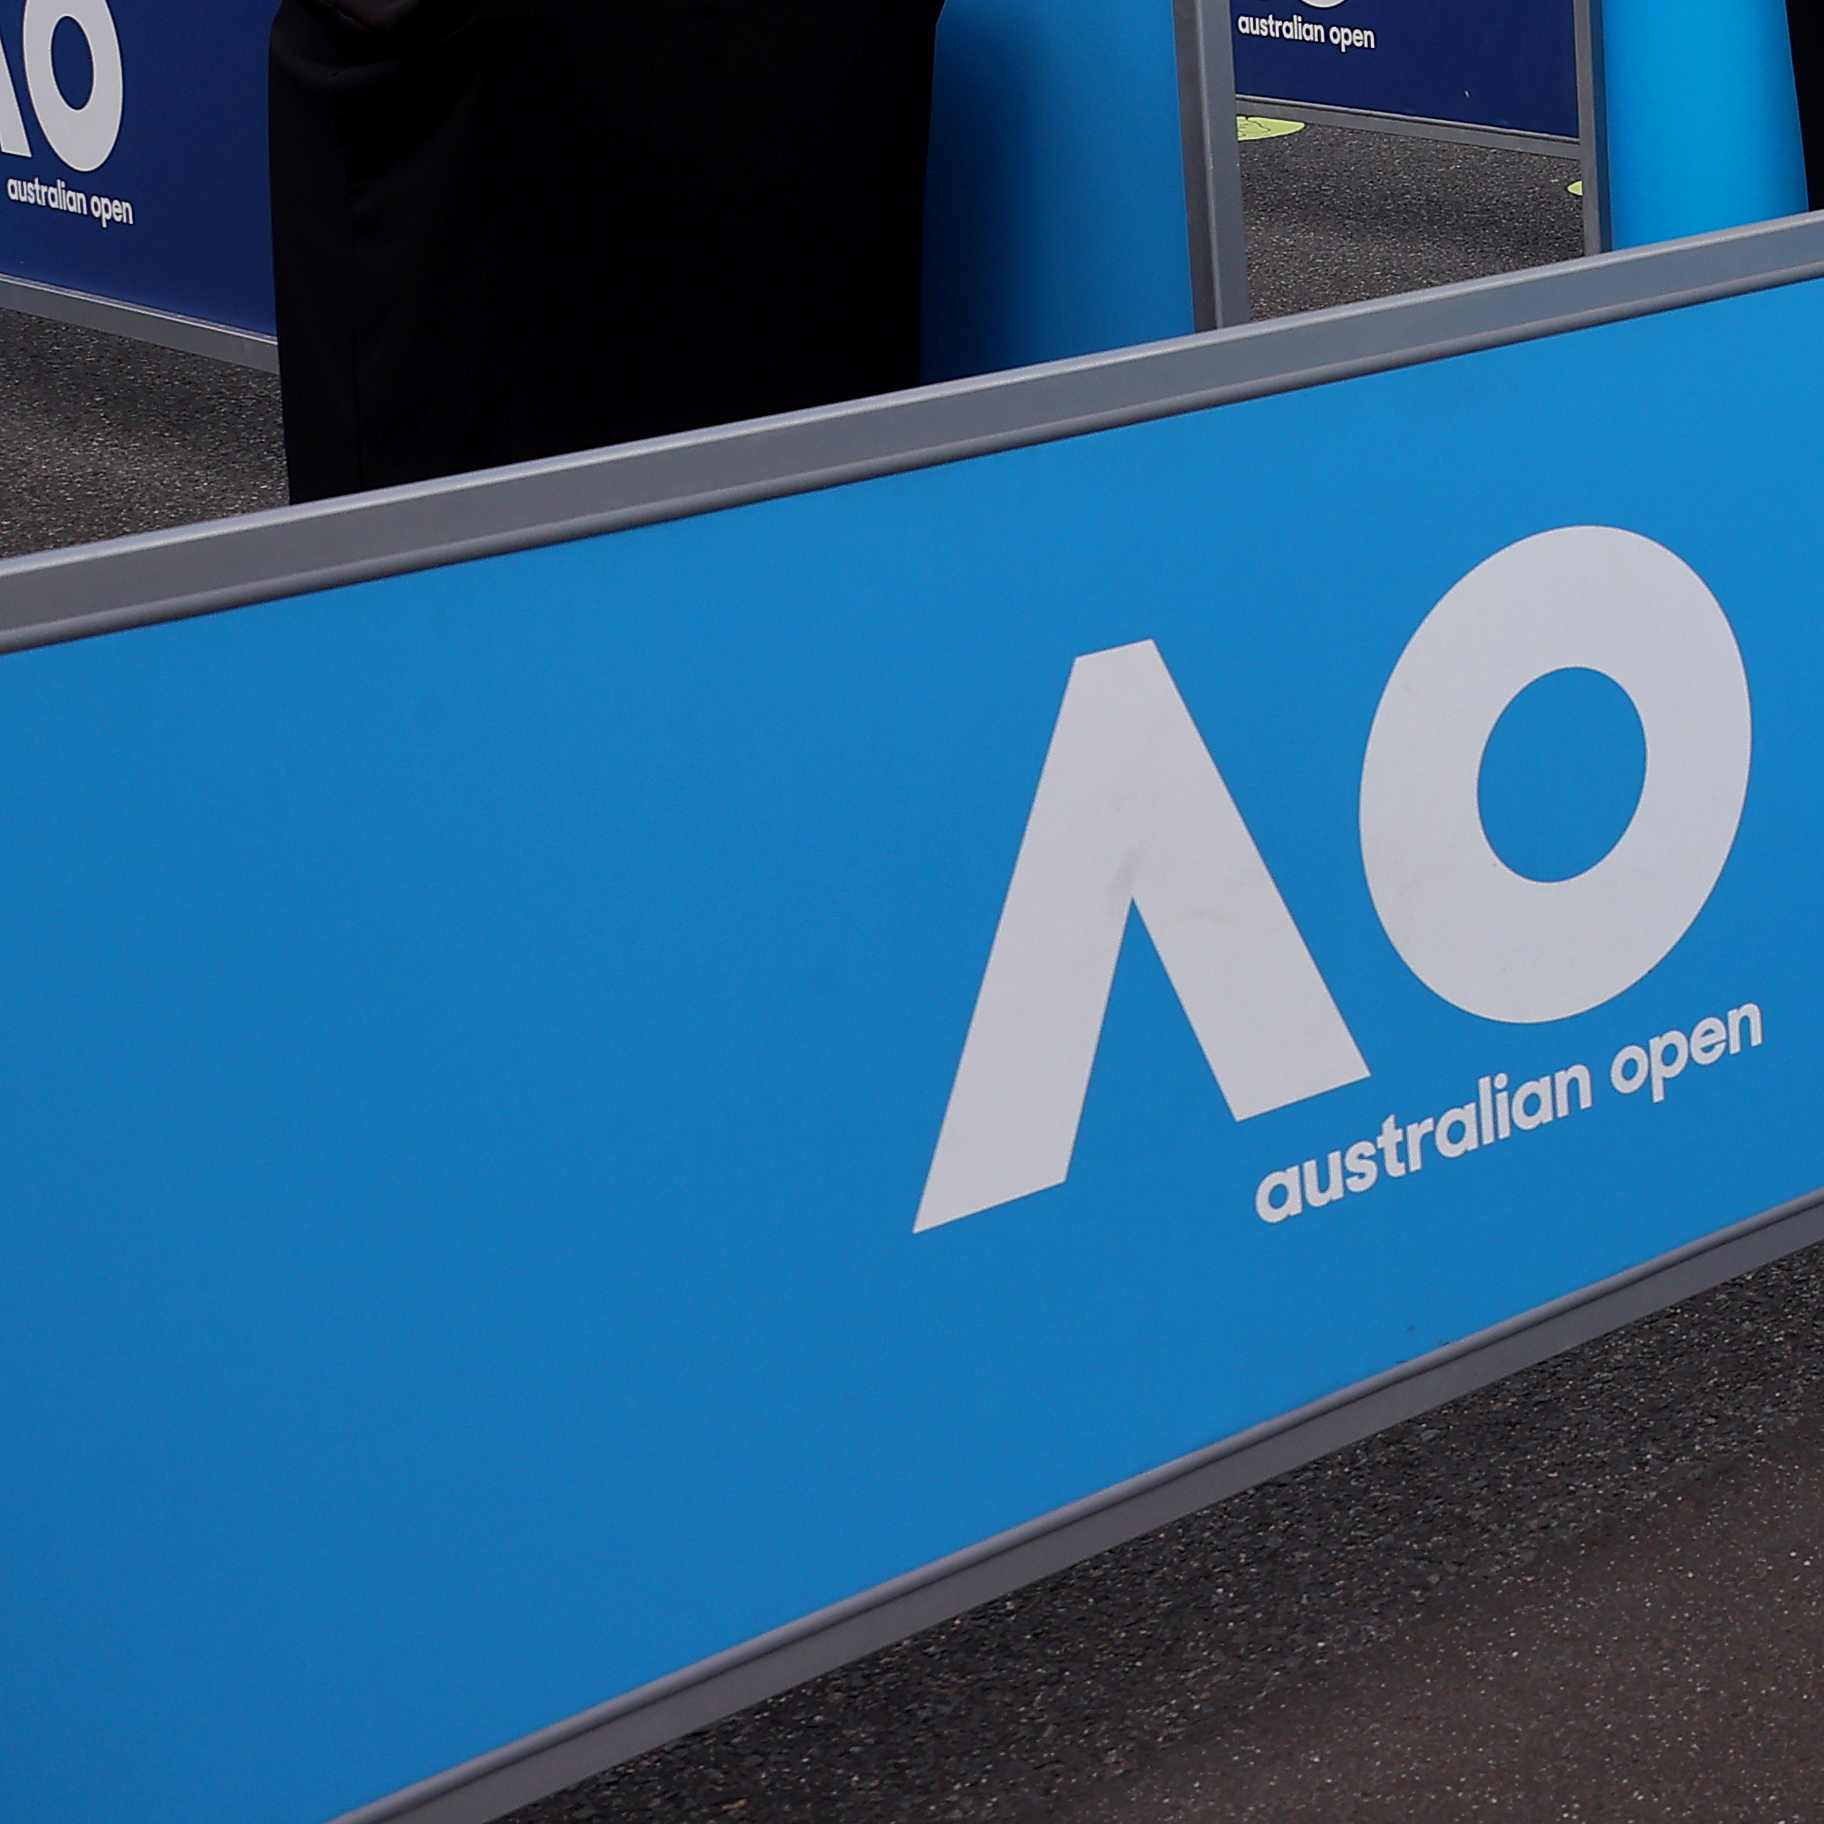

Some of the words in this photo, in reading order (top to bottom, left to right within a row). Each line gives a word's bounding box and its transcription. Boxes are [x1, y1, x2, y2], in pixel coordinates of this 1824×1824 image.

[1237, 14, 1325, 44] australian
[1329, 25, 1376, 53] open
[7, 177, 88, 216] australian
[90, 194, 134, 228] open
[912, 524, 1753, 1234] AO
[1253, 1058, 1593, 1225] australian
[1609, 1000, 1764, 1104] open
